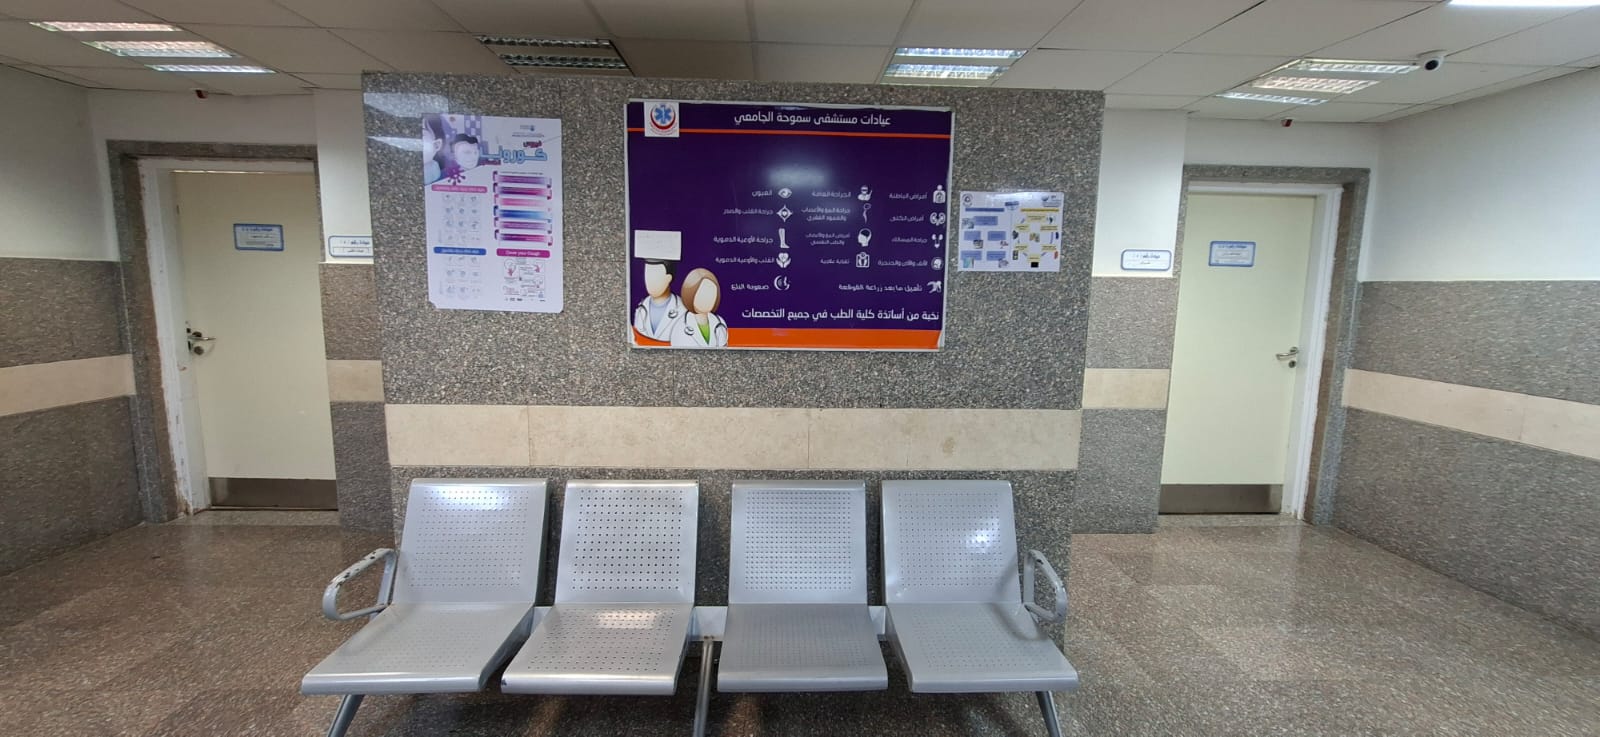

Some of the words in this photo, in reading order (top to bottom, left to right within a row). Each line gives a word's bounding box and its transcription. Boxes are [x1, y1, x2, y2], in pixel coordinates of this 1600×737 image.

[734, 111, 774, 125] الجامعي
[776, 112, 811, 126] سموحة
[813, 113, 858, 125] مستشفى
[860, 114, 891, 127] عيادات
[480, 145, 547, 164] كورونا
[751, 189, 773, 197] العيون
[830, 190, 852, 199] الجراحة
[909, 191, 928, 200] أمراض
[904, 283, 923, 293] تأهيل
[741, 307, 785, 319] التخصصات
[786, 310, 810, 321] جميع
[812, 310, 828, 322] في
[830, 308, 854, 320] الطب
[856, 309, 875, 321] كلية
[877, 308, 905, 320] أساتذة
[906, 312, 920, 322] من
[921, 311, 939, 321] نخبة
